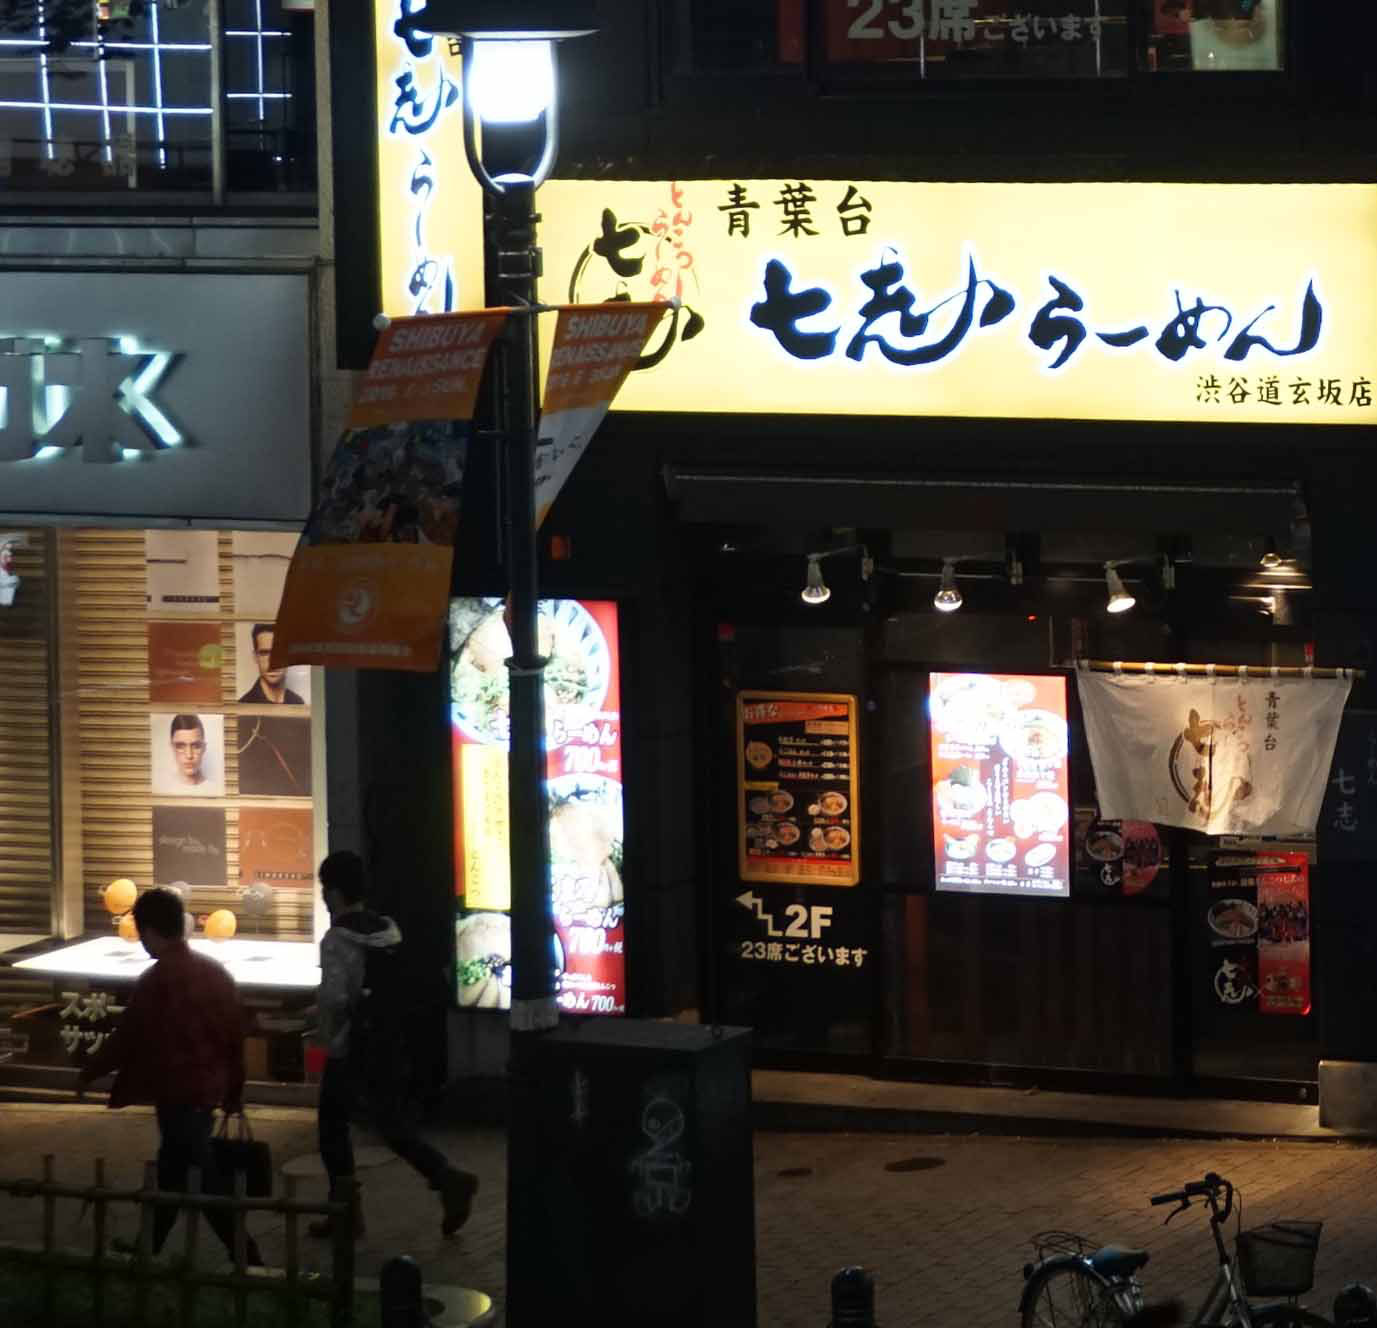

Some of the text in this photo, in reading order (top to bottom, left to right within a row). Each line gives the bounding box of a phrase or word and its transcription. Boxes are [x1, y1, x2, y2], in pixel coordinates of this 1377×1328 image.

[716, 183, 876, 238] 青葉台
[1195, 375, 1375, 410] 渋谷道玄坂店
[1263, 689, 1281, 752] 青葉台
[784, 904, 834, 940] 2F
[741, 940, 868, 968] 23席ございます
